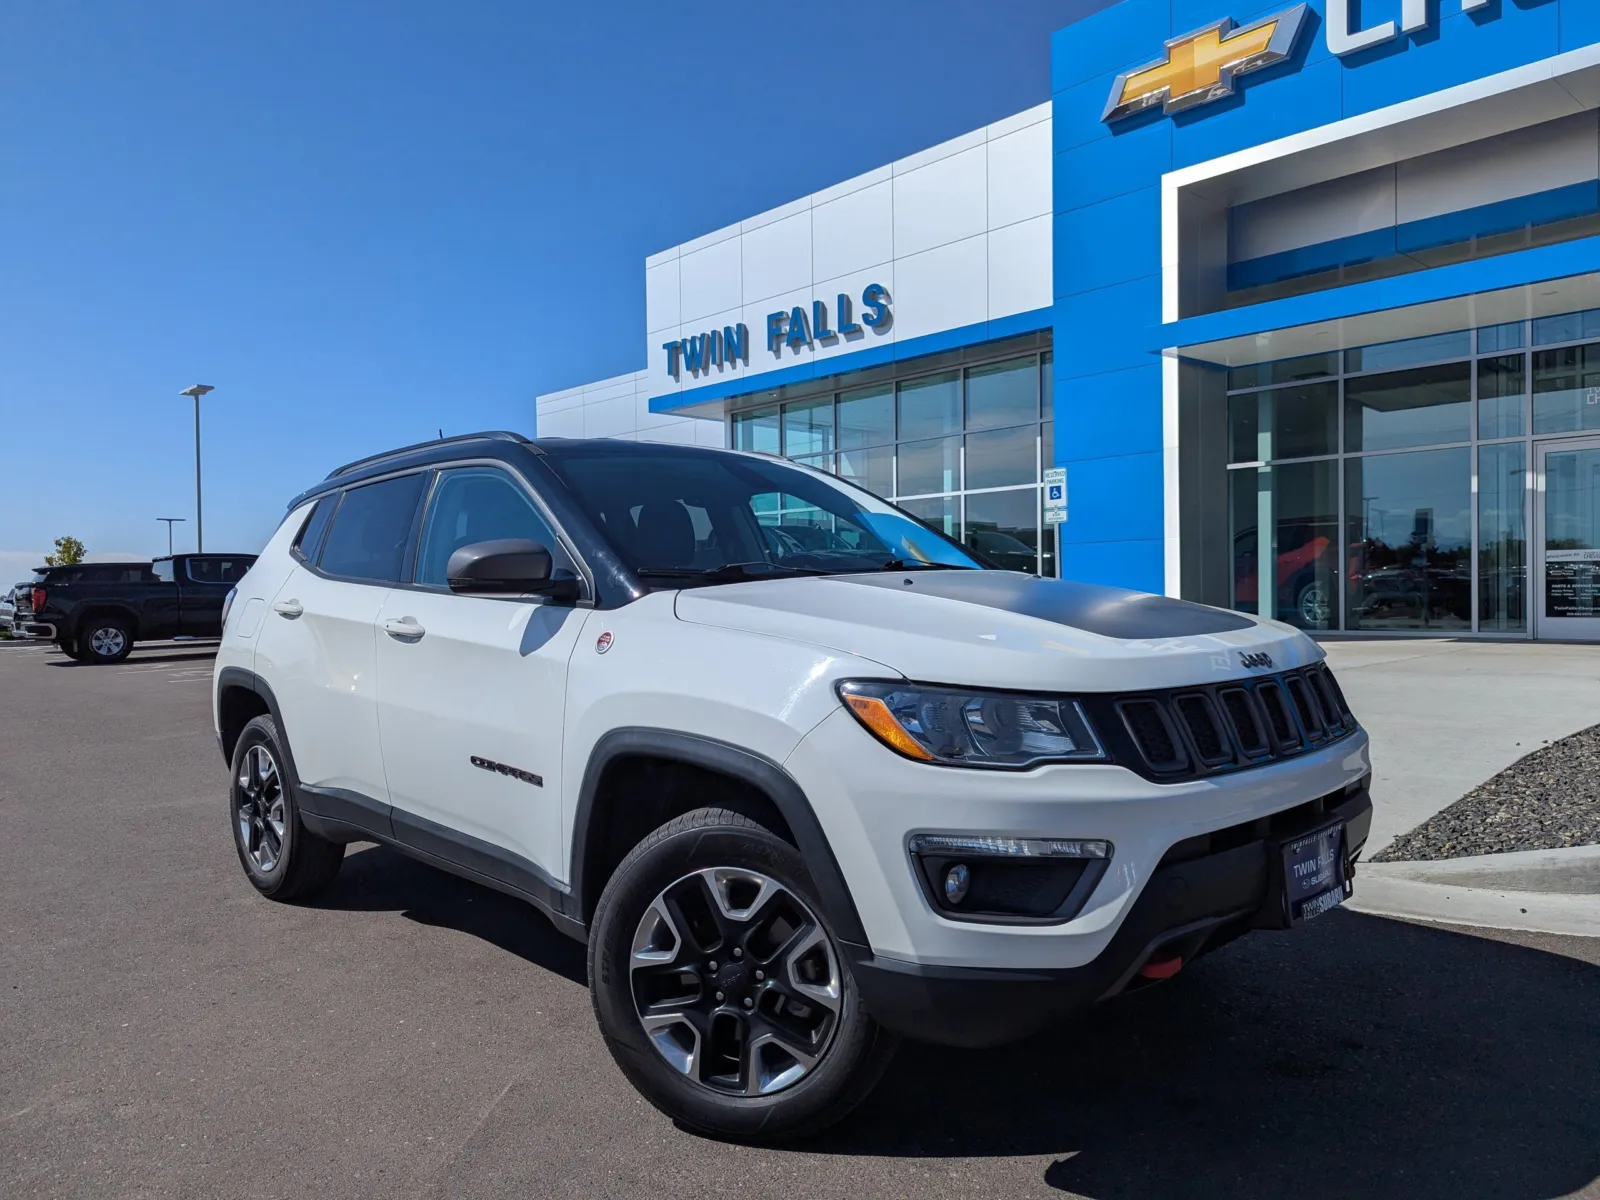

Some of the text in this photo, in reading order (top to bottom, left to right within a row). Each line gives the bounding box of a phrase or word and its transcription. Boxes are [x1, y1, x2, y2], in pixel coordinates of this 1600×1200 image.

[662, 283, 890, 379] TWIN FALLS
[1237, 651, 1273, 668] Jeep
[1293, 848, 1335, 878] TWIN FALLS
[1302, 899, 1321, 914] TWIN
[1319, 885, 1344, 913] SUBARU
[1303, 907, 1321, 921] FALLS
